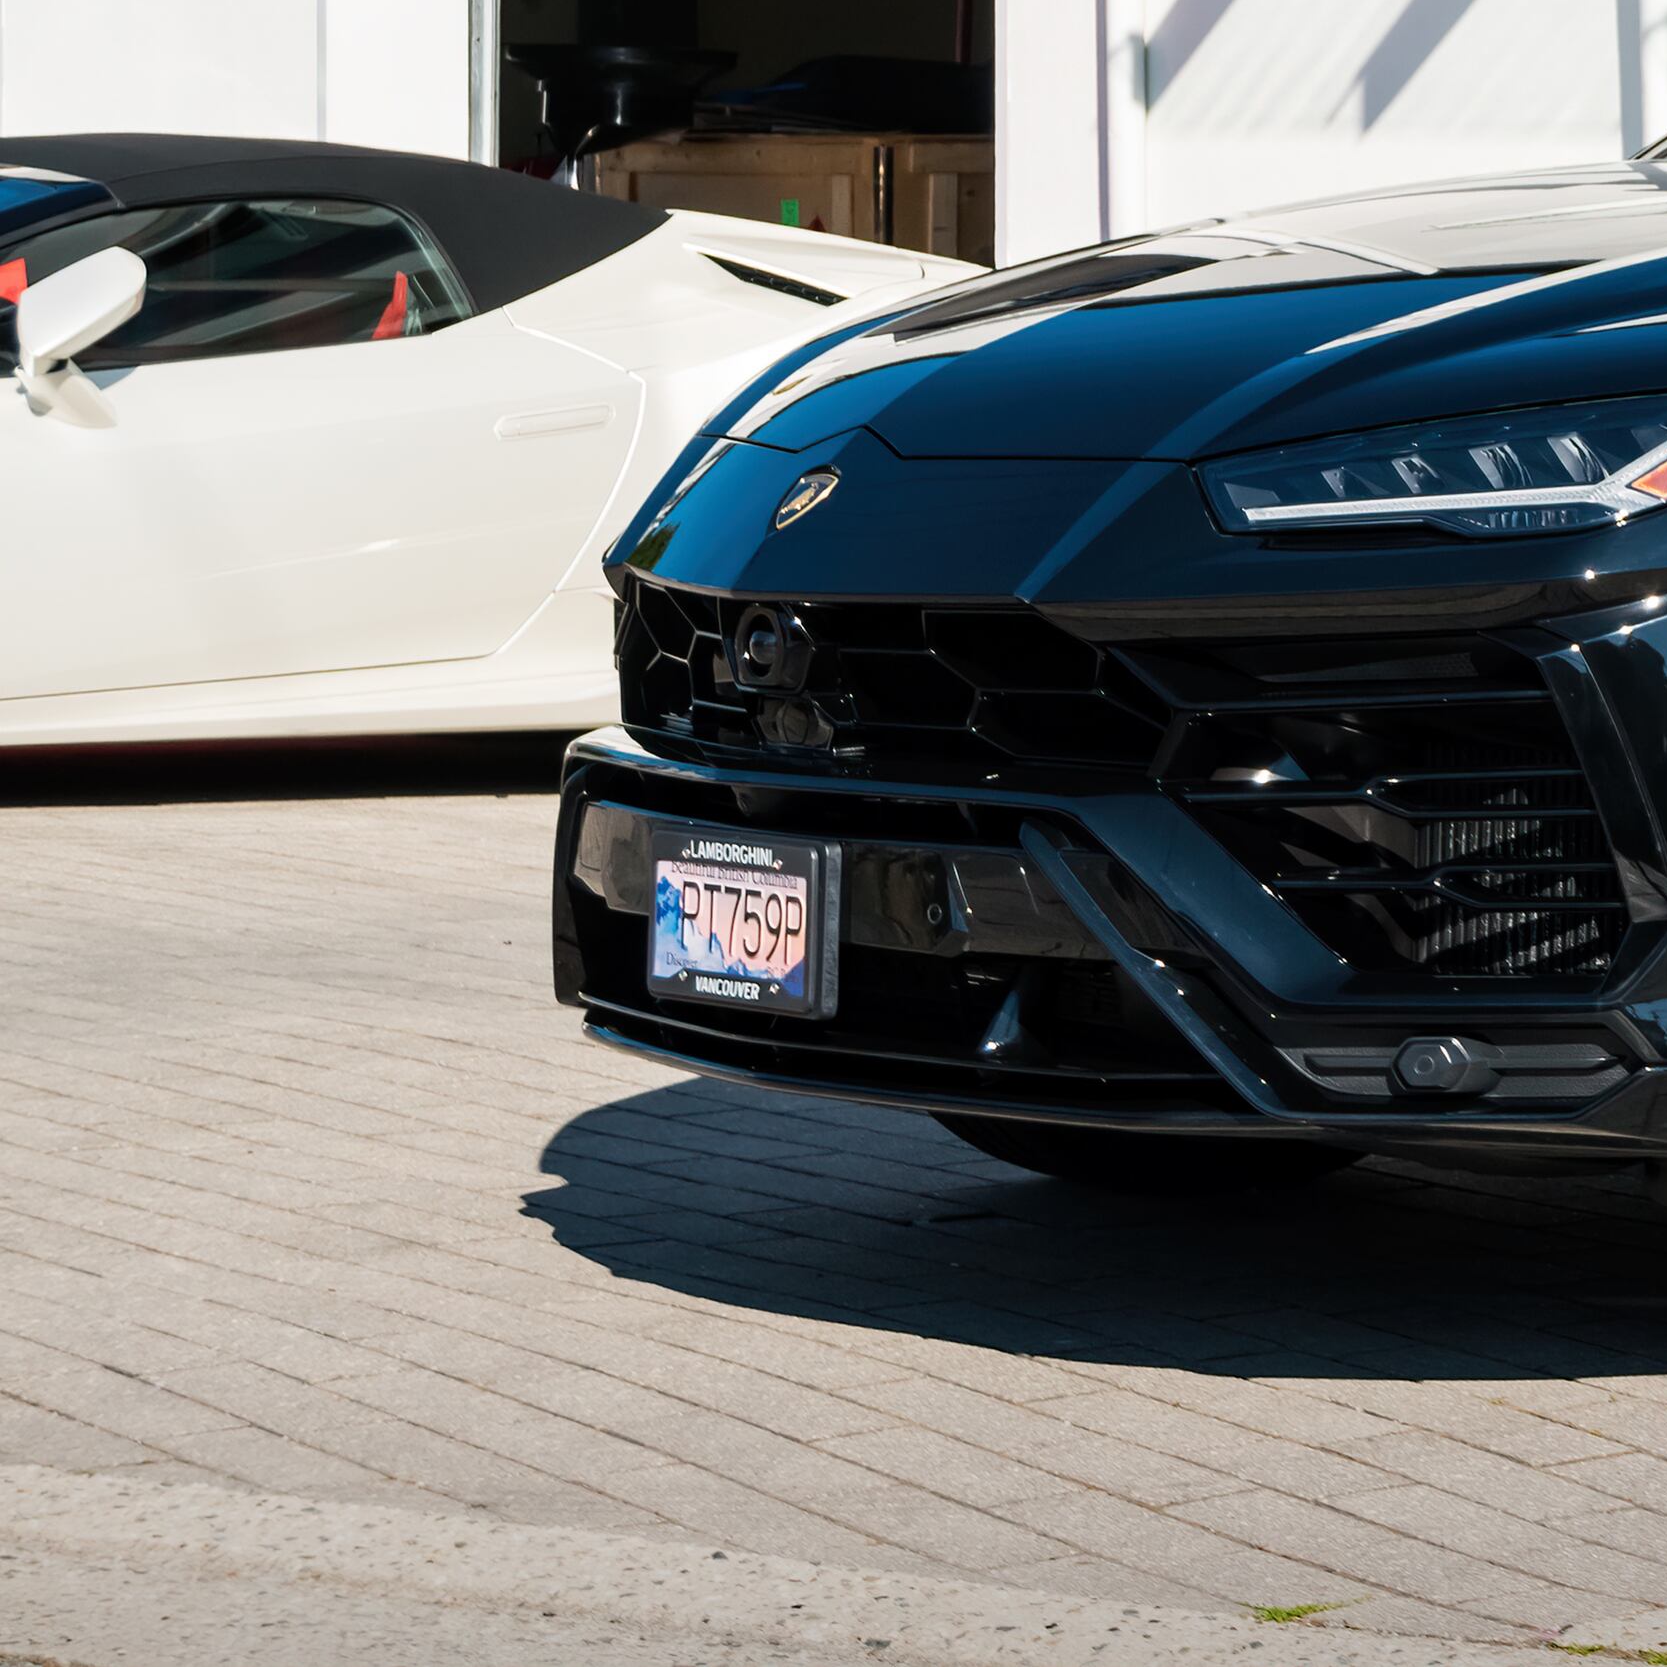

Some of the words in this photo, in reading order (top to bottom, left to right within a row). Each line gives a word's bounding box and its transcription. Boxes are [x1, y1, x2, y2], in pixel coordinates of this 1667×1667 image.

[690, 839, 774, 868] LAMBORGHINI
[681, 881, 802, 965] PT759P
[695, 974, 761, 1001] VANCOUVER
